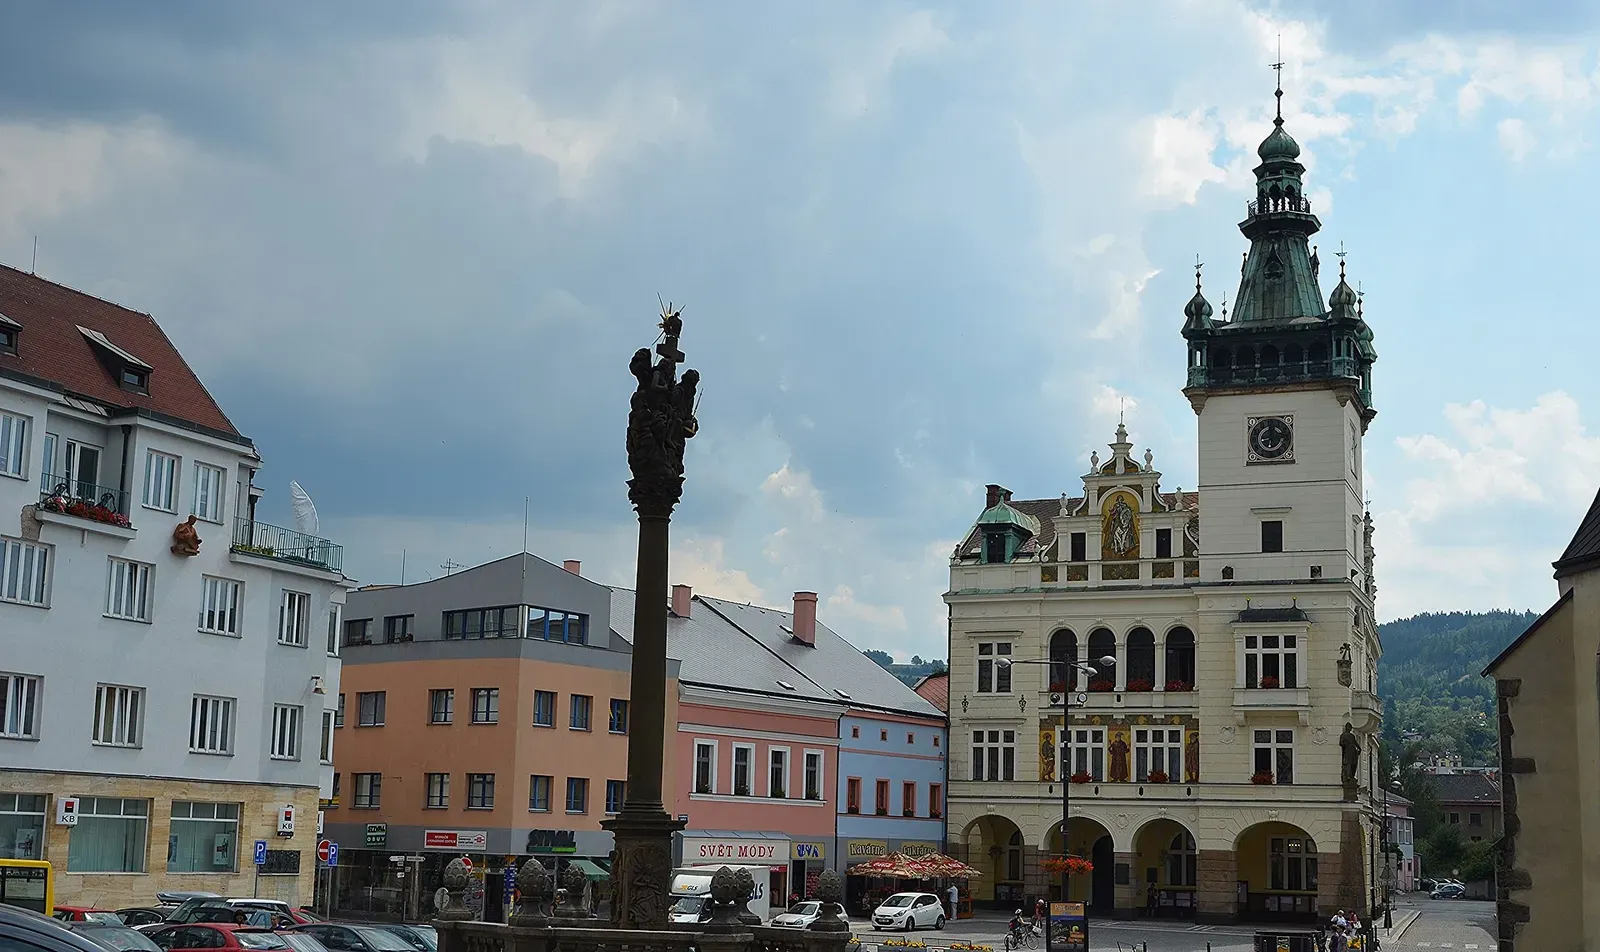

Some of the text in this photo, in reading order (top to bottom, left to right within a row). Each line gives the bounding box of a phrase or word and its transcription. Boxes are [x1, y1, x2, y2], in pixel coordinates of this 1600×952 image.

[256, 843, 264, 857] P
[329, 846, 336, 859] P
[699, 843, 775, 858] SVĚT MÓDY
[850, 843, 886, 857] Kavárna
